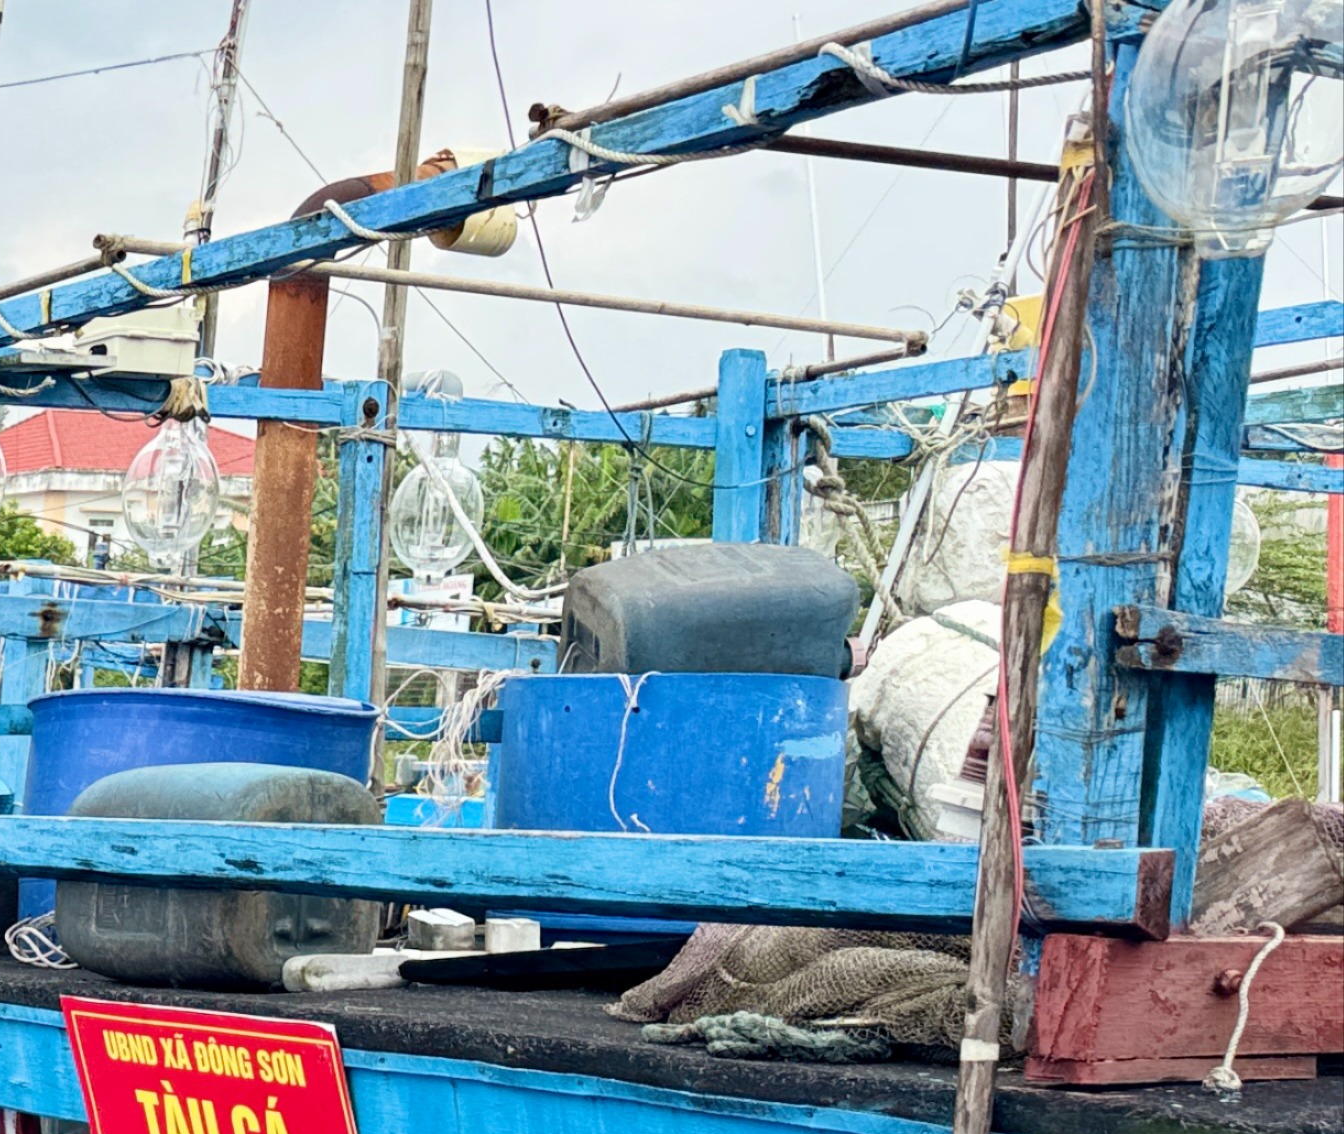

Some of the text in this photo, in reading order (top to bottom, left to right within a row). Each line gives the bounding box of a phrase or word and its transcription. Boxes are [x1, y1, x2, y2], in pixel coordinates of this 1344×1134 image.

[102, 1029, 307, 1088] UBND XÃ ĐÔNG SƠN
